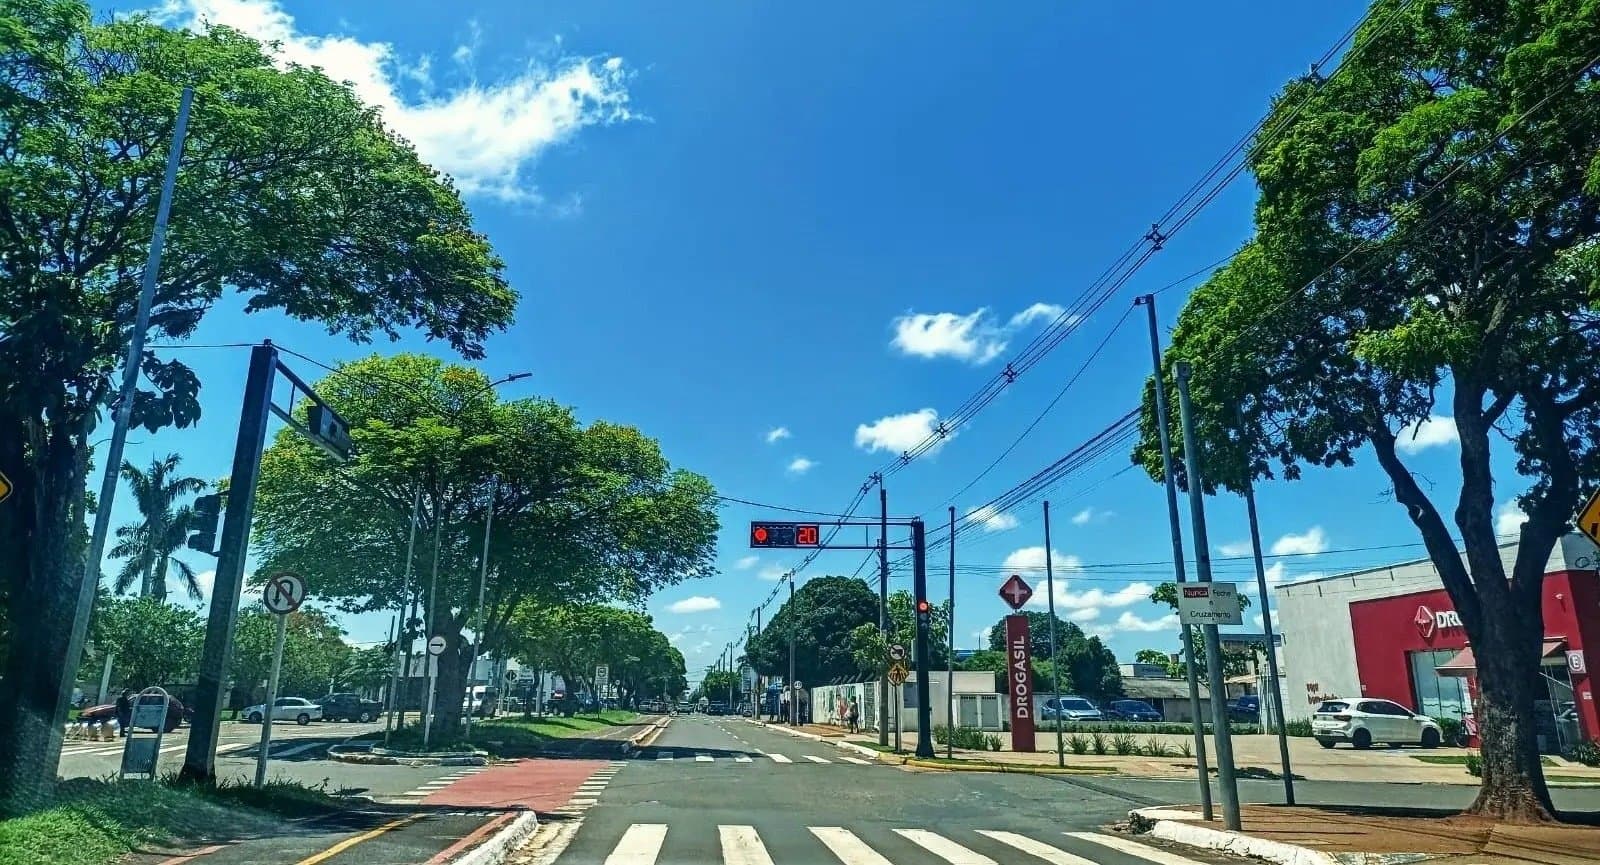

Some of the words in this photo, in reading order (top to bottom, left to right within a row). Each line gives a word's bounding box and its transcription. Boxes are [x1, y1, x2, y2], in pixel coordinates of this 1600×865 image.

[798, 527, 817, 543] 20
[1184, 589, 1208, 597] Nunca
[1013, 635, 1029, 719] DROGASIL
